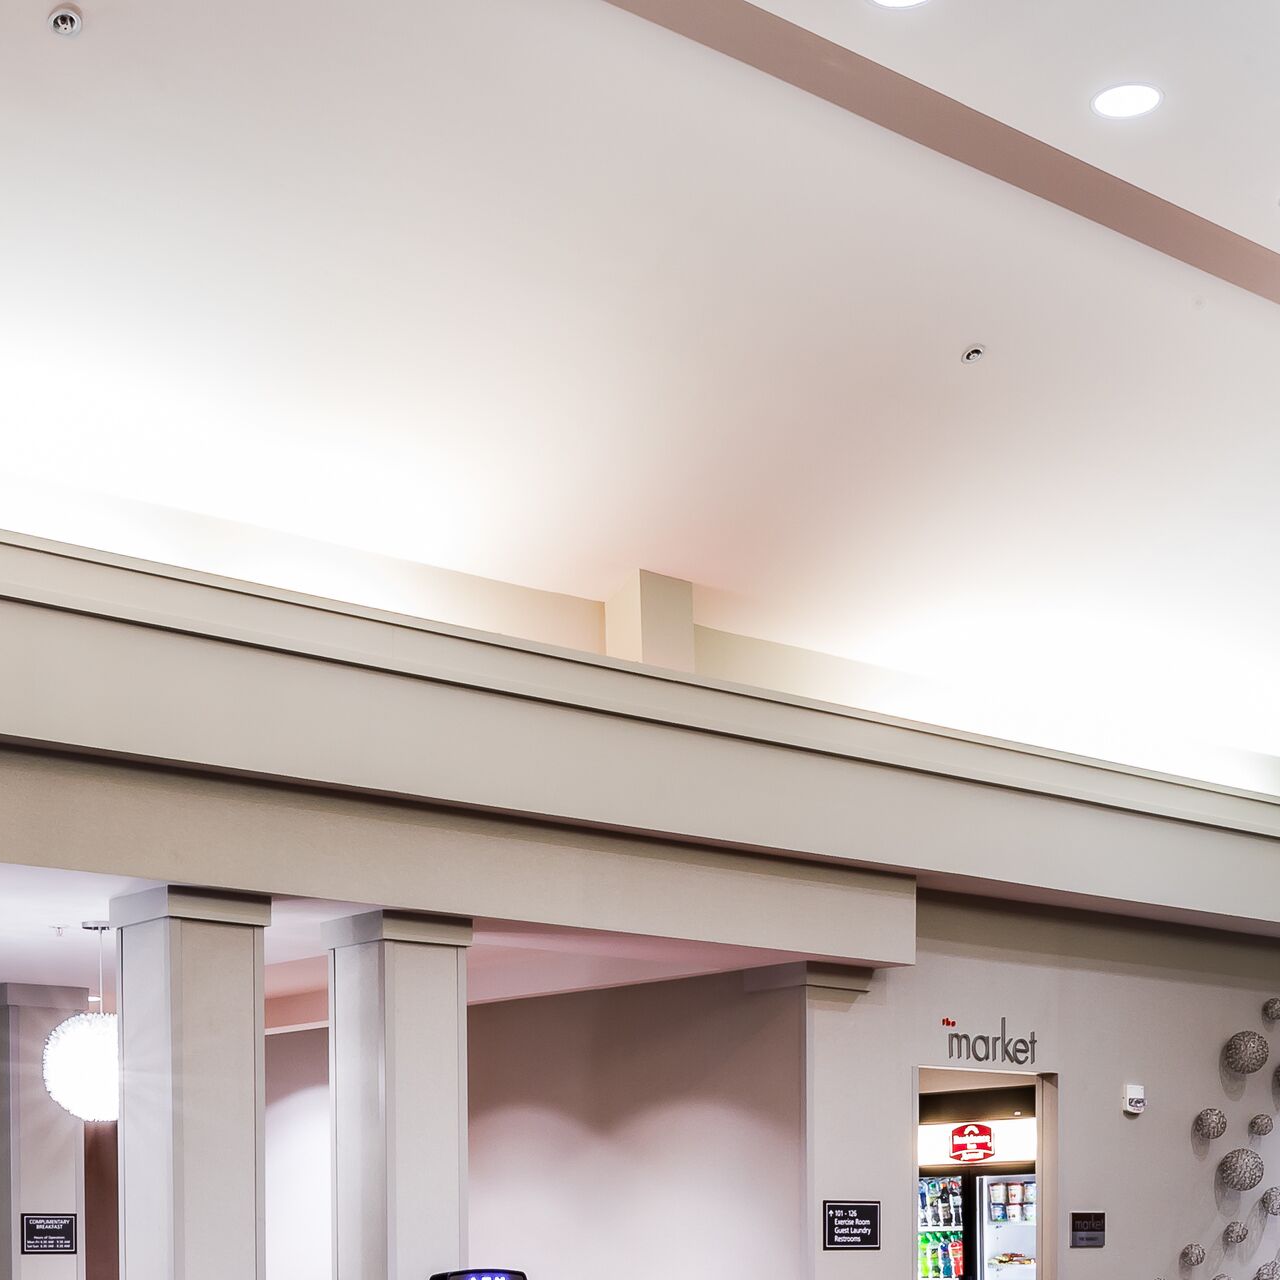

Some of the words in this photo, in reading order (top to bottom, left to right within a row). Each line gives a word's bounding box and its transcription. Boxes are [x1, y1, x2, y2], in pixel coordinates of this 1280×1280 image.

[942, 1017, 956, 1027] the
[948, 1016, 1038, 1065] market
[850, 1227, 871, 1235] Laundry
